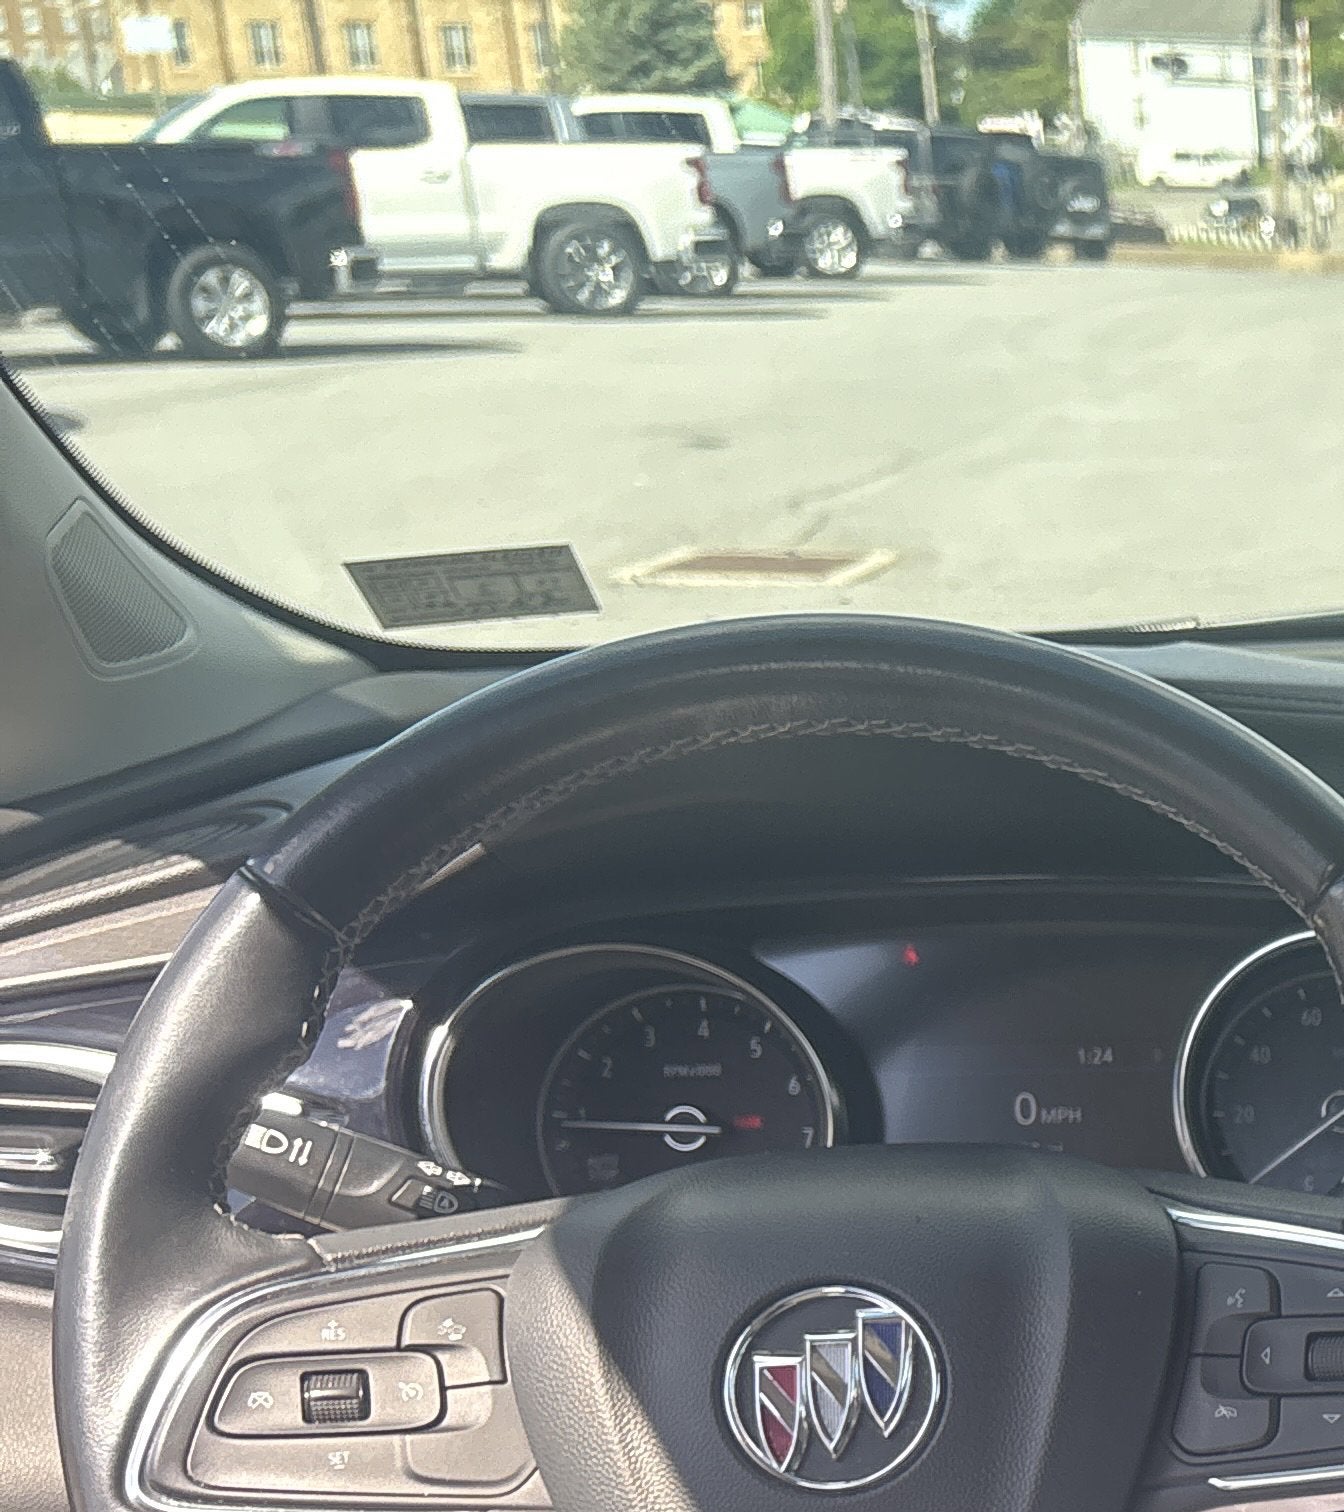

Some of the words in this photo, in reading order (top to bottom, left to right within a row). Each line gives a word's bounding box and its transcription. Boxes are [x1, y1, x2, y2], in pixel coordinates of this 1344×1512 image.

[749, 1036, 763, 1059] 5
[1014, 1091, 1037, 1126] 0
[1040, 1107, 1083, 1125] MPH
[801, 1127, 814, 1149] 7
[321, 1328, 346, 1342] RES
[327, 1451, 351, 1466] SET
